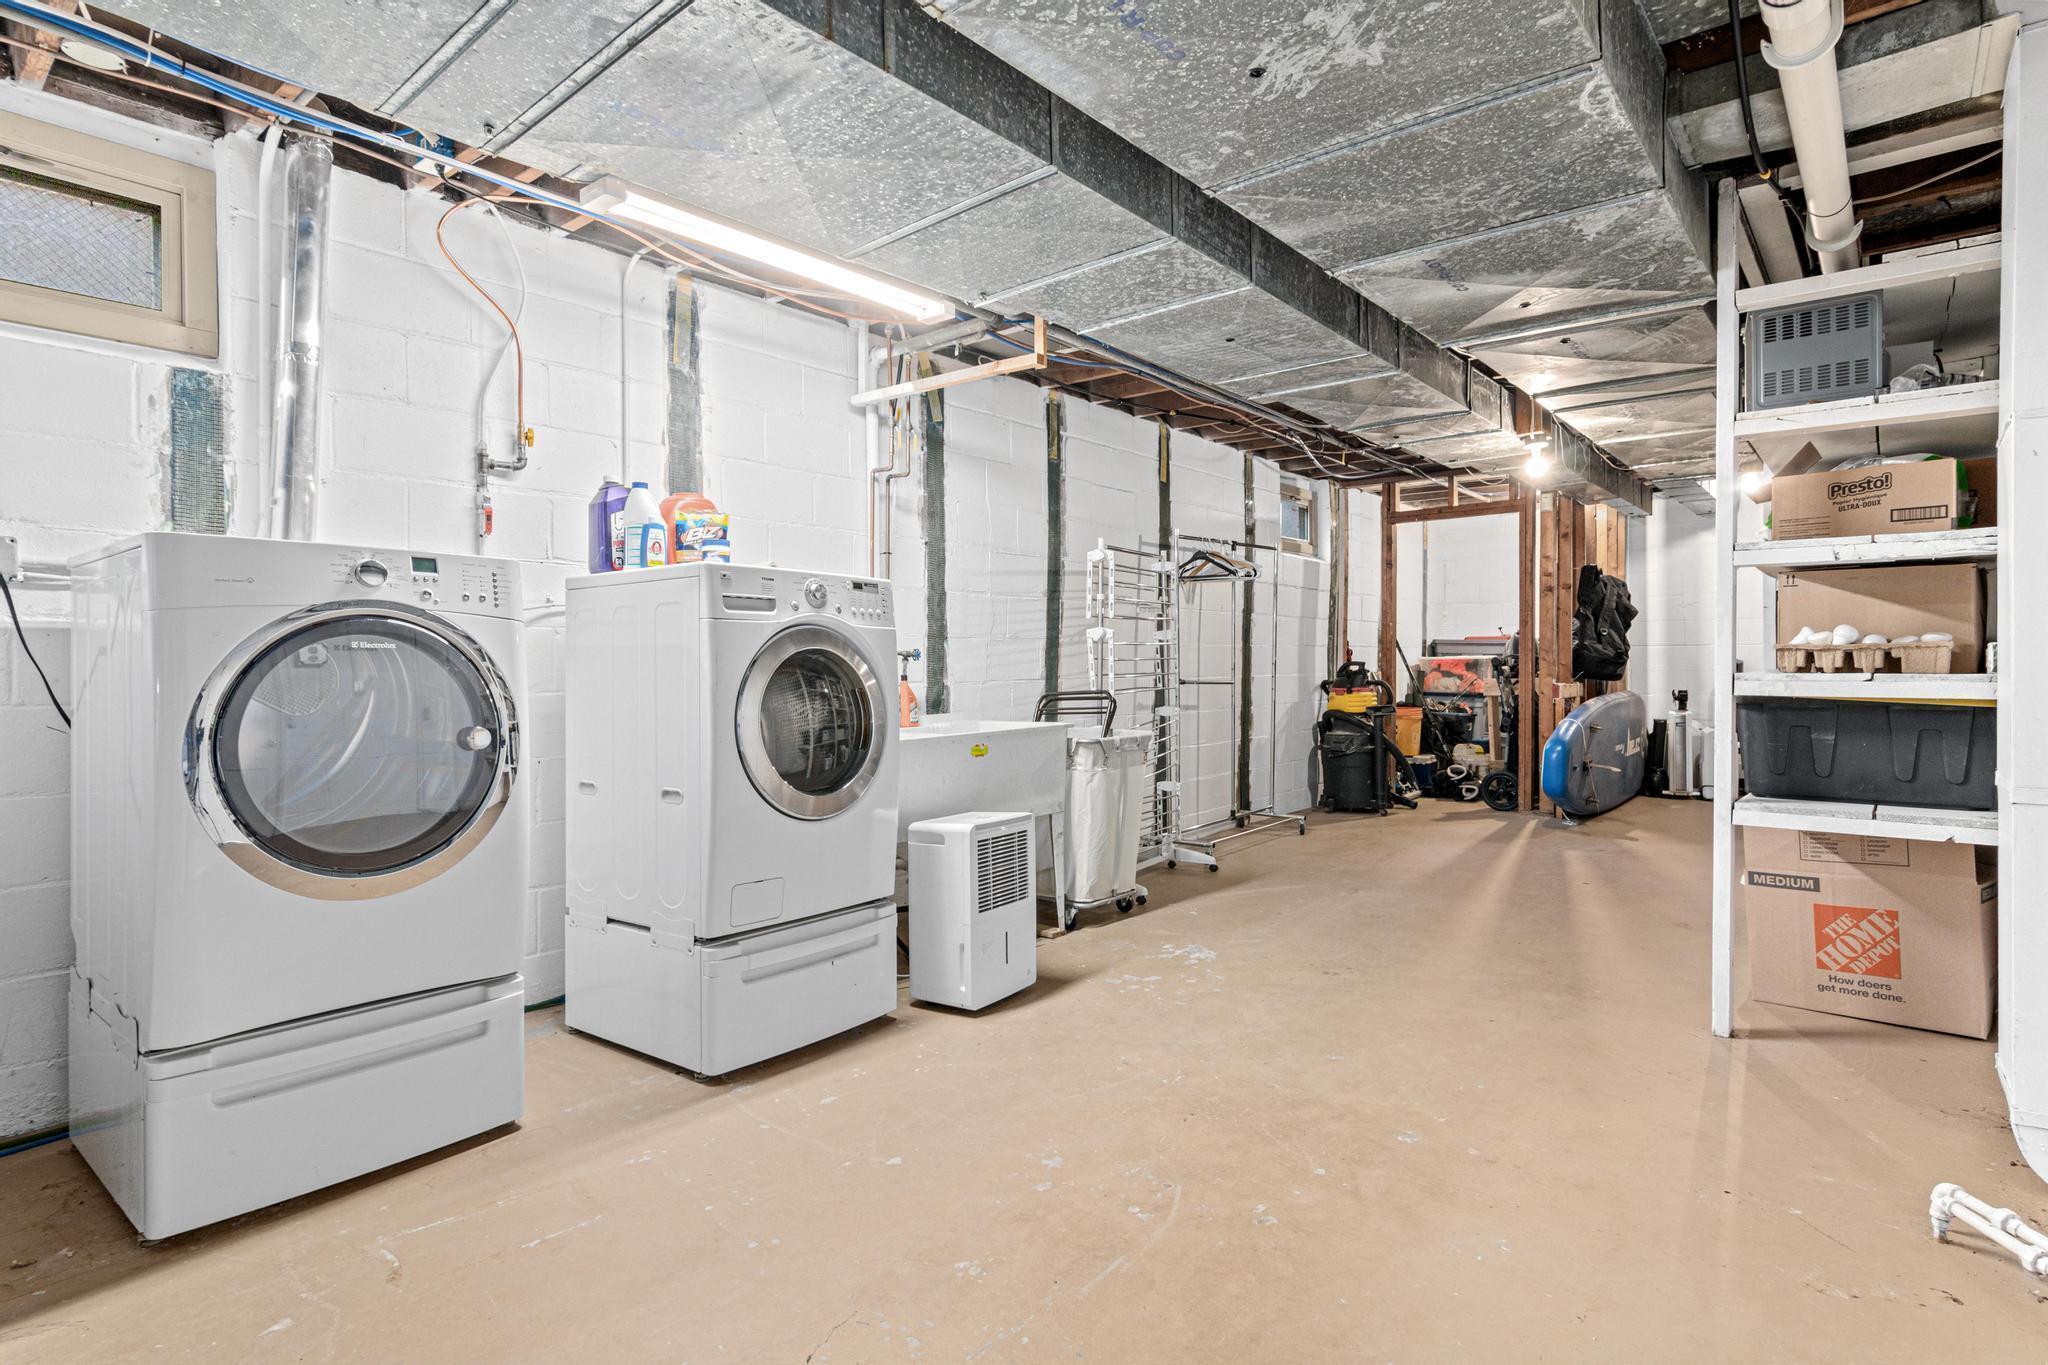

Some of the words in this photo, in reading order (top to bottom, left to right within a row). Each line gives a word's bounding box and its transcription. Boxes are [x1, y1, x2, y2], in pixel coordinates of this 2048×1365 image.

[1829, 473, 1891, 499] Presto!
[1838, 499, 1881, 512] ULTRA-DOUX
[359, 641, 397, 649] Electrolux
[1753, 873, 1814, 889] MEDIUM
[1822, 913, 1857, 940] THE
[1815, 909, 1900, 972] HOME
[1848, 935, 1900, 974] DEPOT
[1828, 974, 1854, 986] How
[1857, 979, 1892, 991] doers
[1817, 983, 1837, 993] get
[1838, 986, 1869, 998] more
[1872, 991, 1906, 1003] done.
